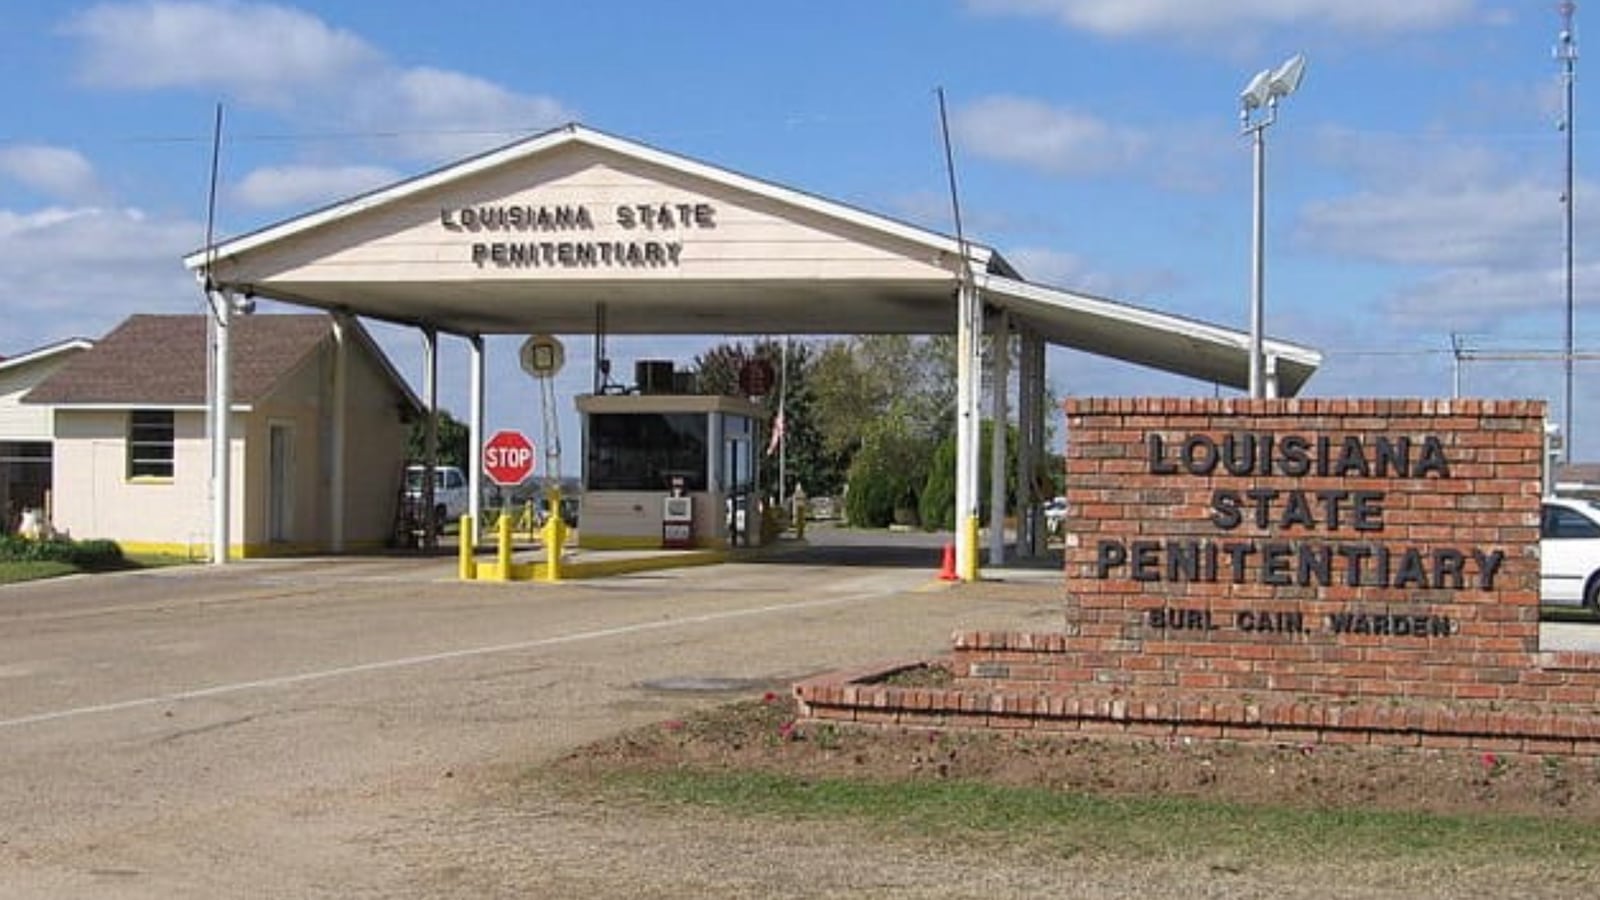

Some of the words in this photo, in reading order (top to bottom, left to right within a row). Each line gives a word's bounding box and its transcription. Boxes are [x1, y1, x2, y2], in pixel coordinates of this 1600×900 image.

[439, 205, 594, 232] LOUISIANA
[616, 204, 716, 229] STATE
[471, 241, 683, 268] PENITENTIARY
[486, 447, 531, 468] STOP
[1148, 433, 1450, 478] LOUISIANA
[1211, 489, 1386, 532] STATE
[1098, 540, 1505, 591] PENITENTIARY
[1149, 609, 1219, 630] BURL
[1330, 613, 1451, 637] WARDEN
